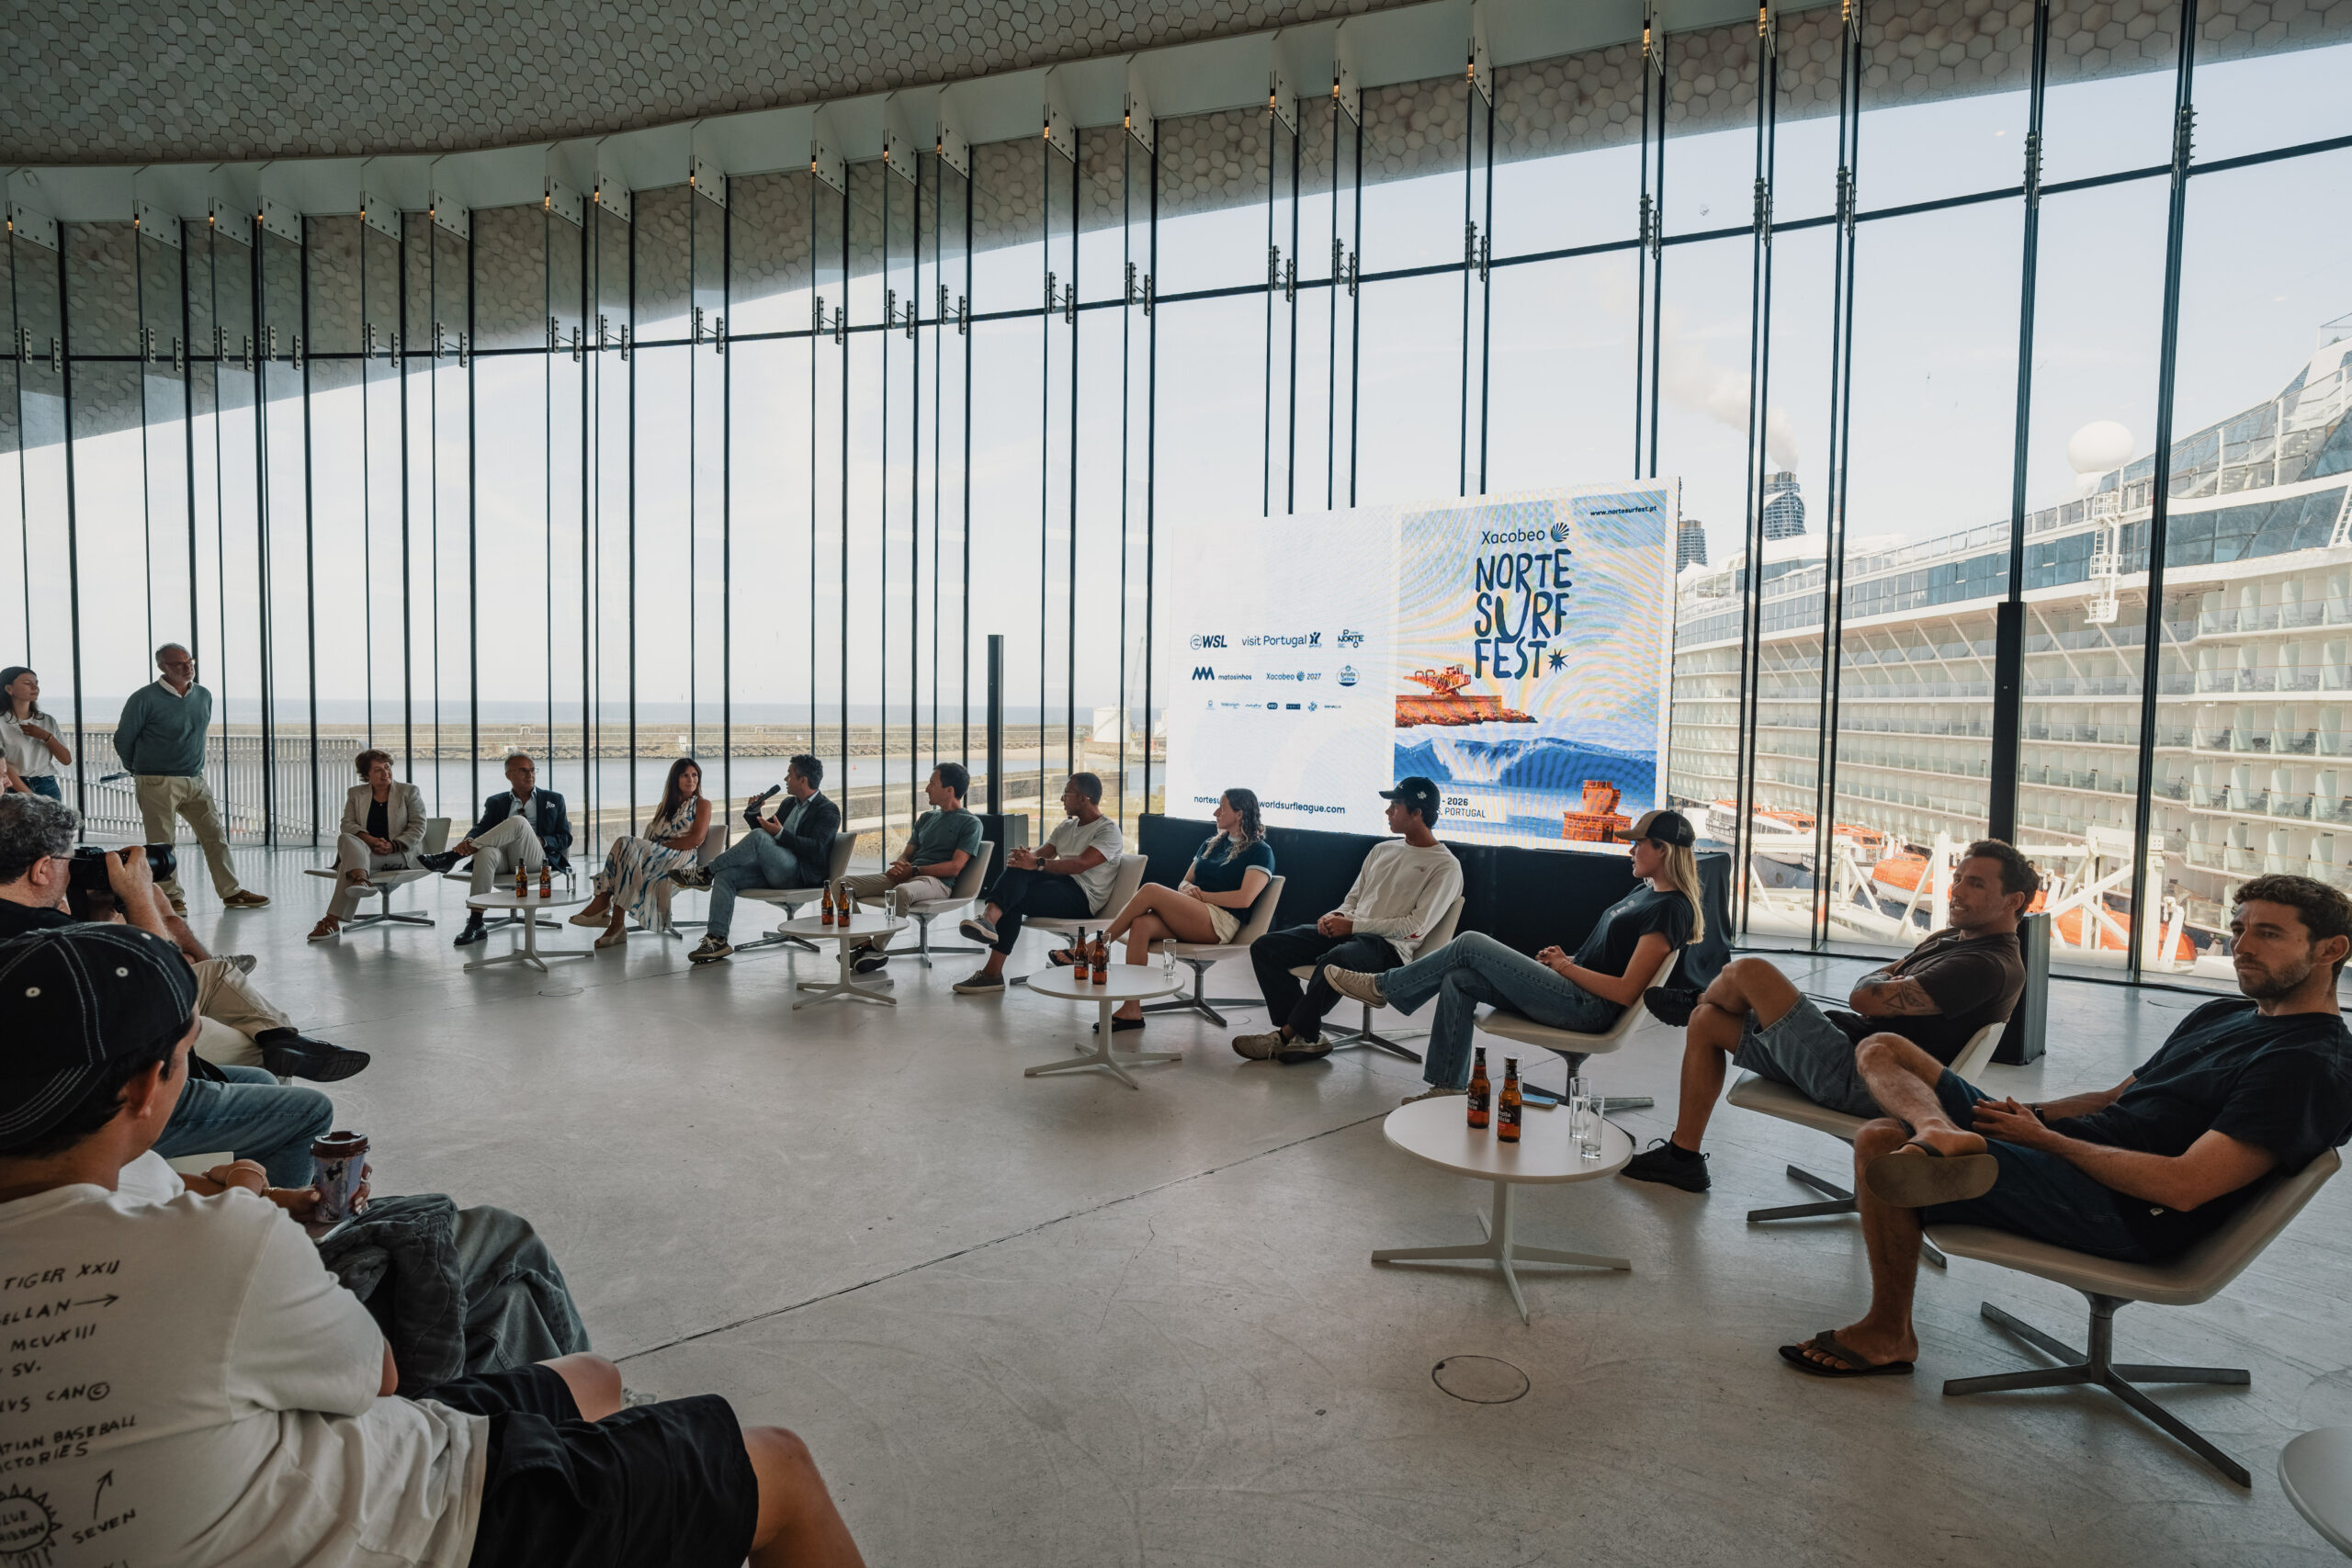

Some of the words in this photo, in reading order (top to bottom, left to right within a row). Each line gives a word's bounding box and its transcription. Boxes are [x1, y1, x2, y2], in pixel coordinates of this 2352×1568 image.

[1590, 505, 1657, 516] www.nortesurfest.pt
[1481, 528, 1545, 545] Xacobeo
[1476, 548, 1572, 592] NORTE
[1475, 592, 1570, 643] SURF
[1203, 635, 1227, 649] WSL
[1242, 636, 1261, 646] visit
[1263, 635, 1307, 648] Portugal
[1475, 636, 1548, 680] FEST
[1266, 671, 1295, 681] Xacobeo
[1193, 795, 1221, 805] nortesu
[1259, 801, 1346, 814] worldsurfleague.com
[1447, 797, 1469, 807] 2026
[1445, 807, 1486, 818] PORTUGAL
[4, 1268, 66, 1291] TIGER
[0, 1298, 72, 1325] ELLAN
[53, 1415, 137, 1444] BASEBALL
[0, 1440, 89, 1473] CTORIES
[0, 1510, 28, 1527] LUE
[72, 1507, 137, 1544] SEVEN
